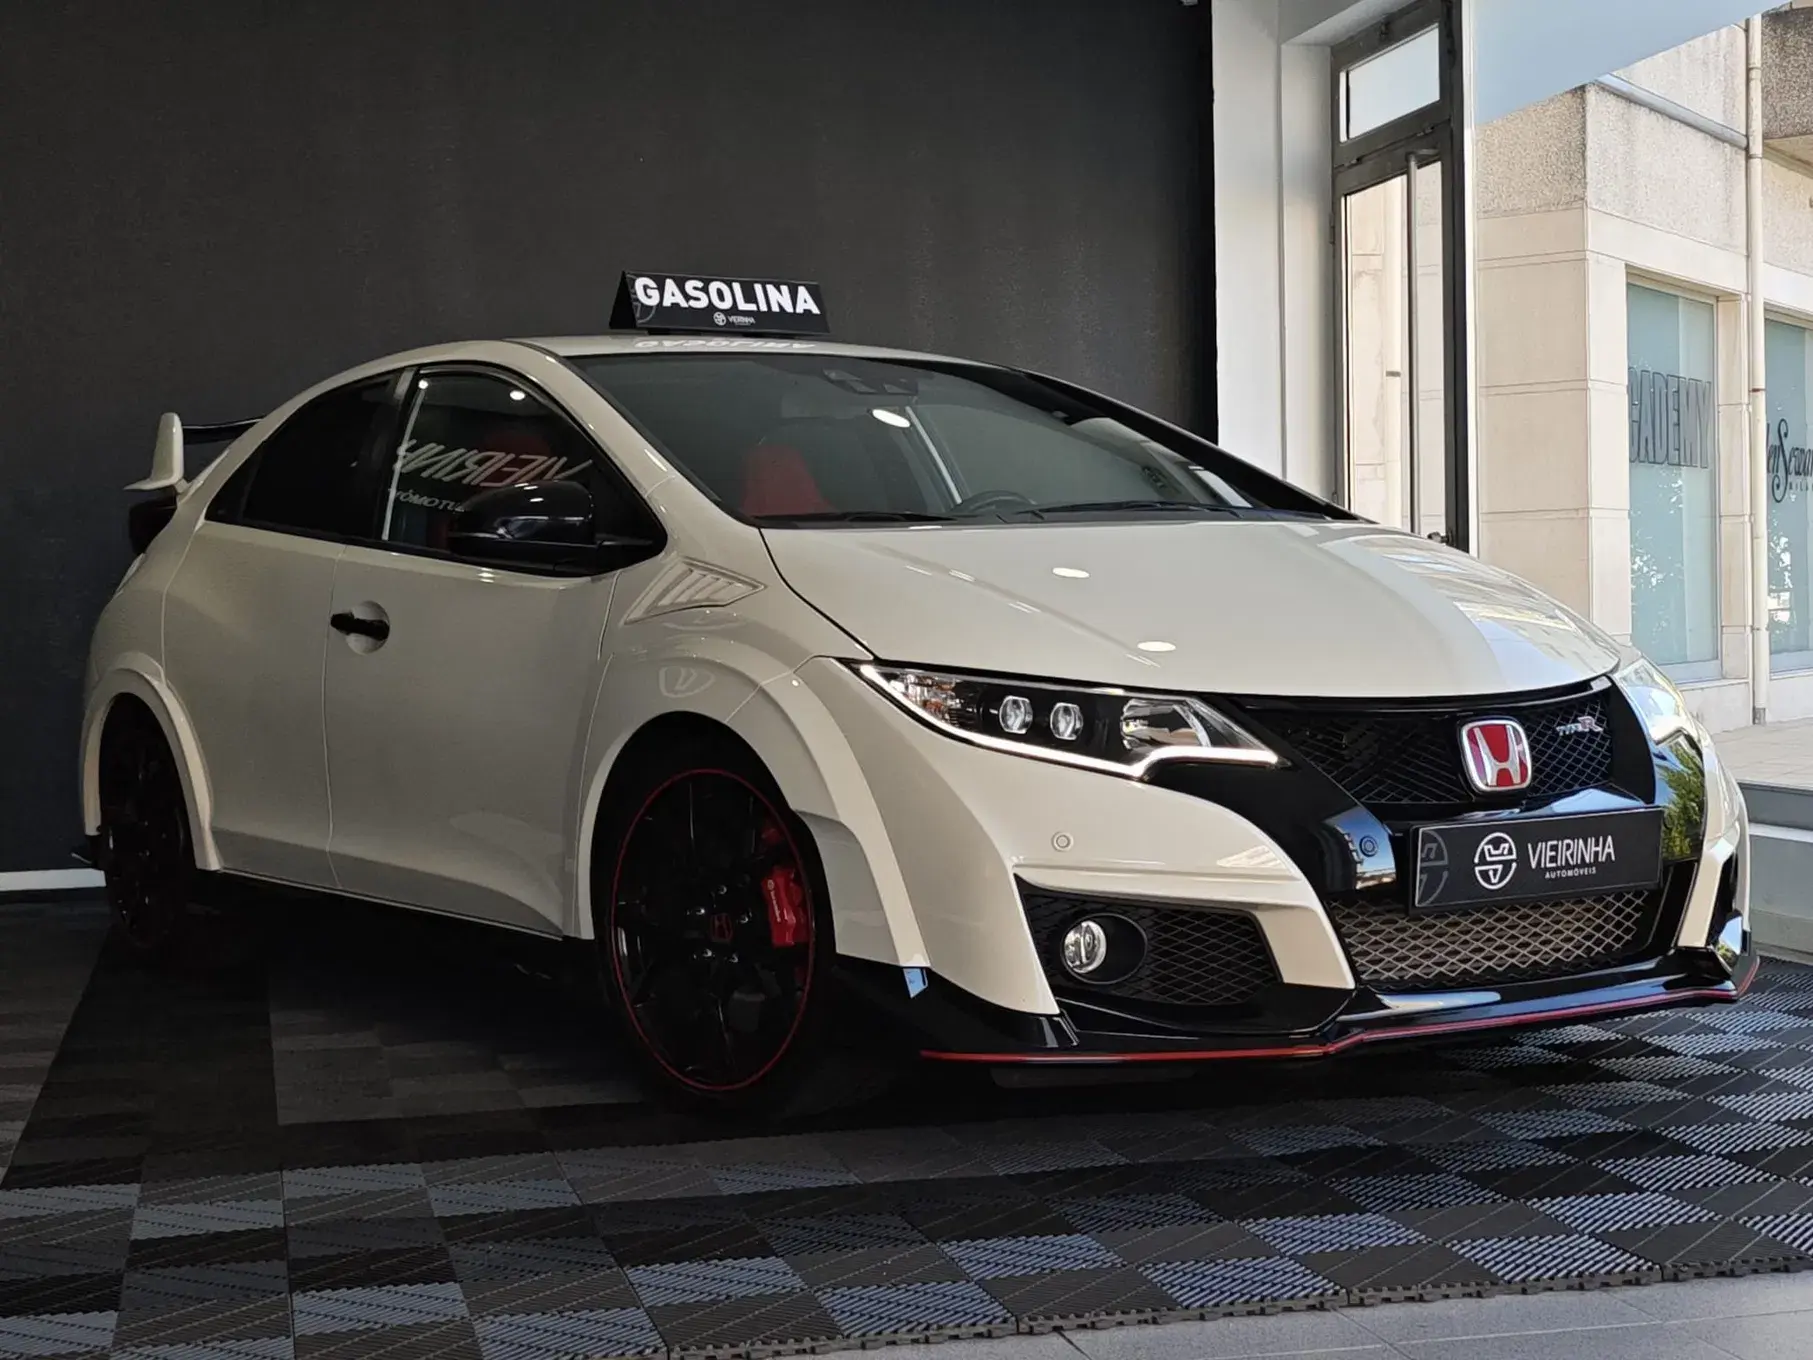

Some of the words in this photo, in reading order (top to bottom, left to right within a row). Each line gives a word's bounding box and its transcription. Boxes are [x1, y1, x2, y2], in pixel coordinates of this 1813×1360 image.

[634, 276, 821, 315] GASOLINA
[1527, 835, 1616, 869] VIEIRINHA
[1544, 866, 1597, 879] AUTOMÓVEIS
